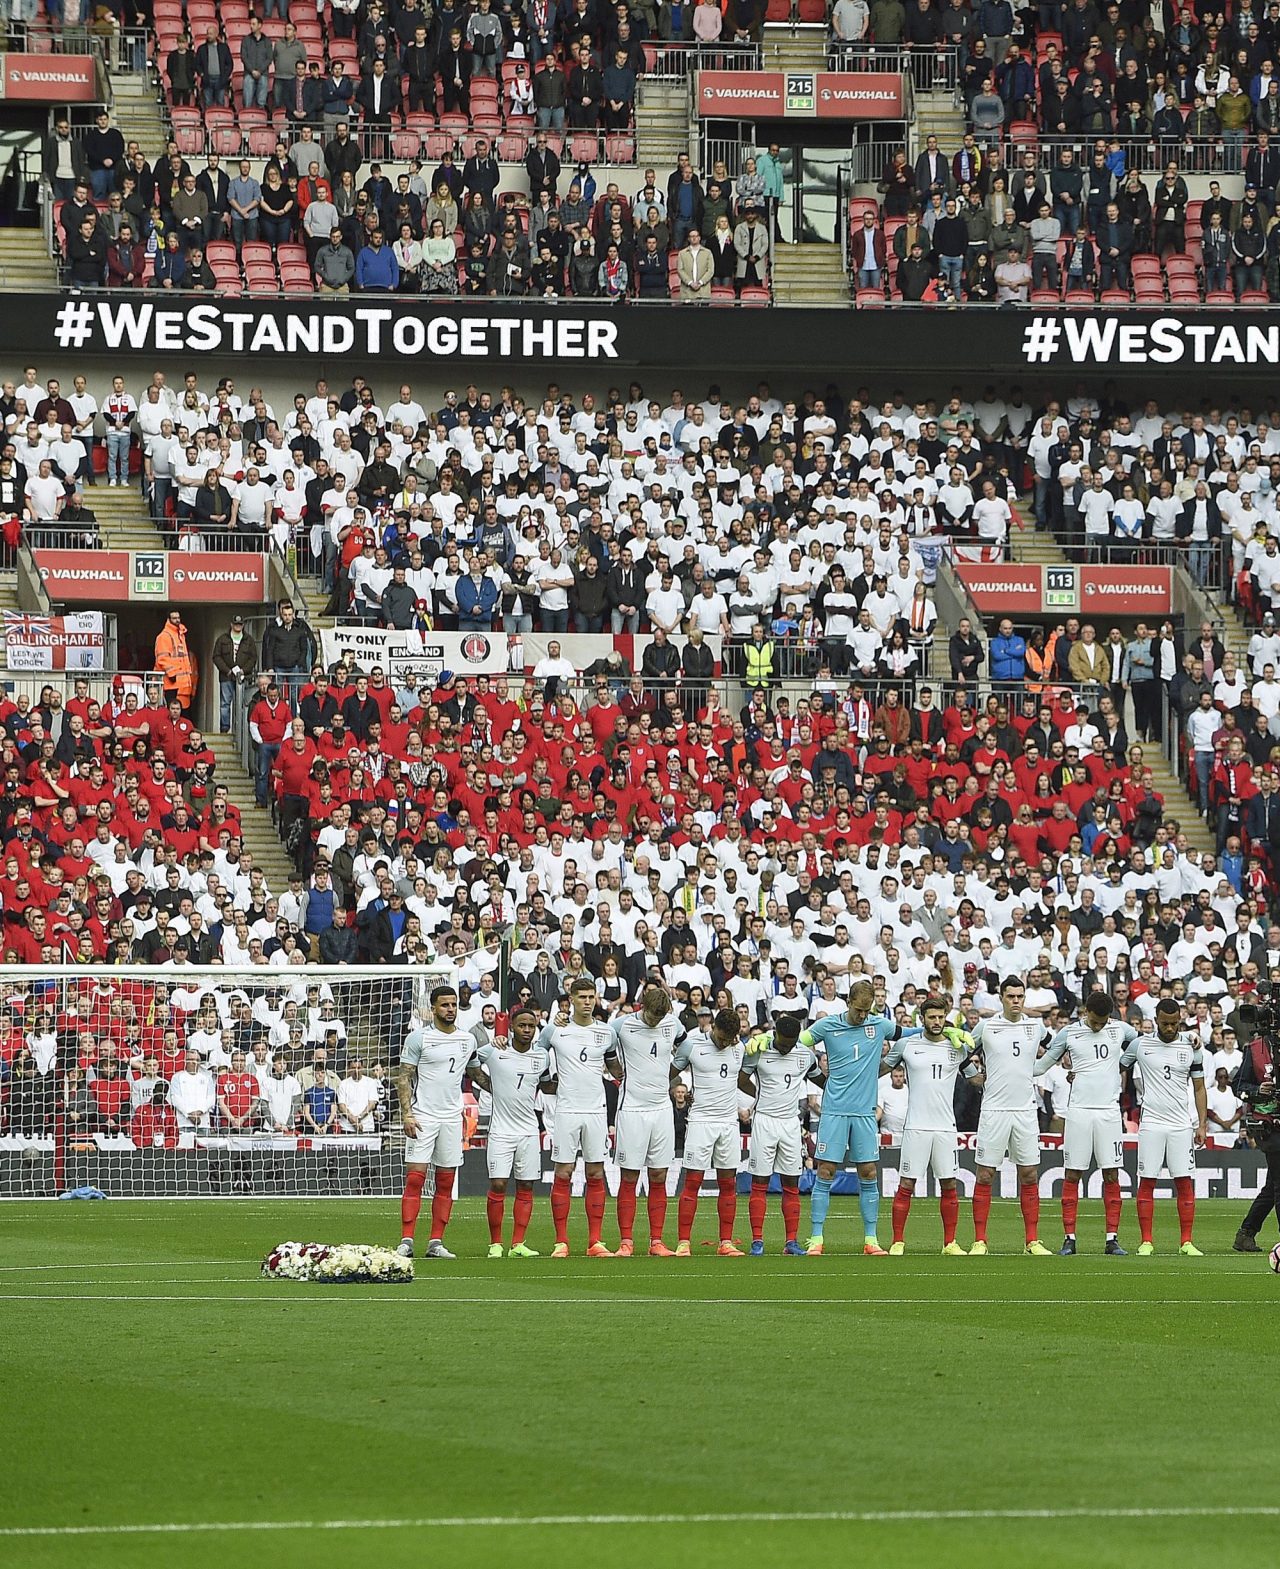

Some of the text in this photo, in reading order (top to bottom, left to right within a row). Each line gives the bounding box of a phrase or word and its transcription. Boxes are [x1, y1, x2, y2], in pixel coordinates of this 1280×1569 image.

[22, 71, 89, 83] VAUXHALL
[715, 88, 780, 99] VAUXHALL
[788, 80, 812, 94] 215
[832, 90, 897, 100] VAUXHALL
[52, 569, 124, 581] VAUXHALL
[137, 561, 163, 575] 112
[187, 570, 258, 582] VAUXHALL
[1048, 574, 1073, 588] 113
[969, 582, 1037, 593] VAUXHALL
[1098, 584, 1166, 595] VAUXHALL
[78, 621, 93, 629] END
[7, 633, 88, 646] GILLINGHAM
[334, 632, 387, 646] MY ONLY
[392, 647, 440, 657] ENAND
[13, 659, 44, 667] FORGET
[579, 1047, 588, 1063] 6
[650, 1042, 657, 1058] 4
[853, 1044, 859, 1060] 1
[1012, 1041, 1020, 1057] 5
[1093, 1043, 1109, 1060] 10
[448, 1057, 456, 1074] 2
[719, 1063, 728, 1079] 8
[931, 1063, 943, 1080] 11
[1163, 1065, 1172, 1081] 3
[516, 1073, 525, 1090] 7
[784, 1074, 792, 1090] 9
[1113, 1141, 1122, 1156] 10
[1188, 1148, 1195, 1165] 3
